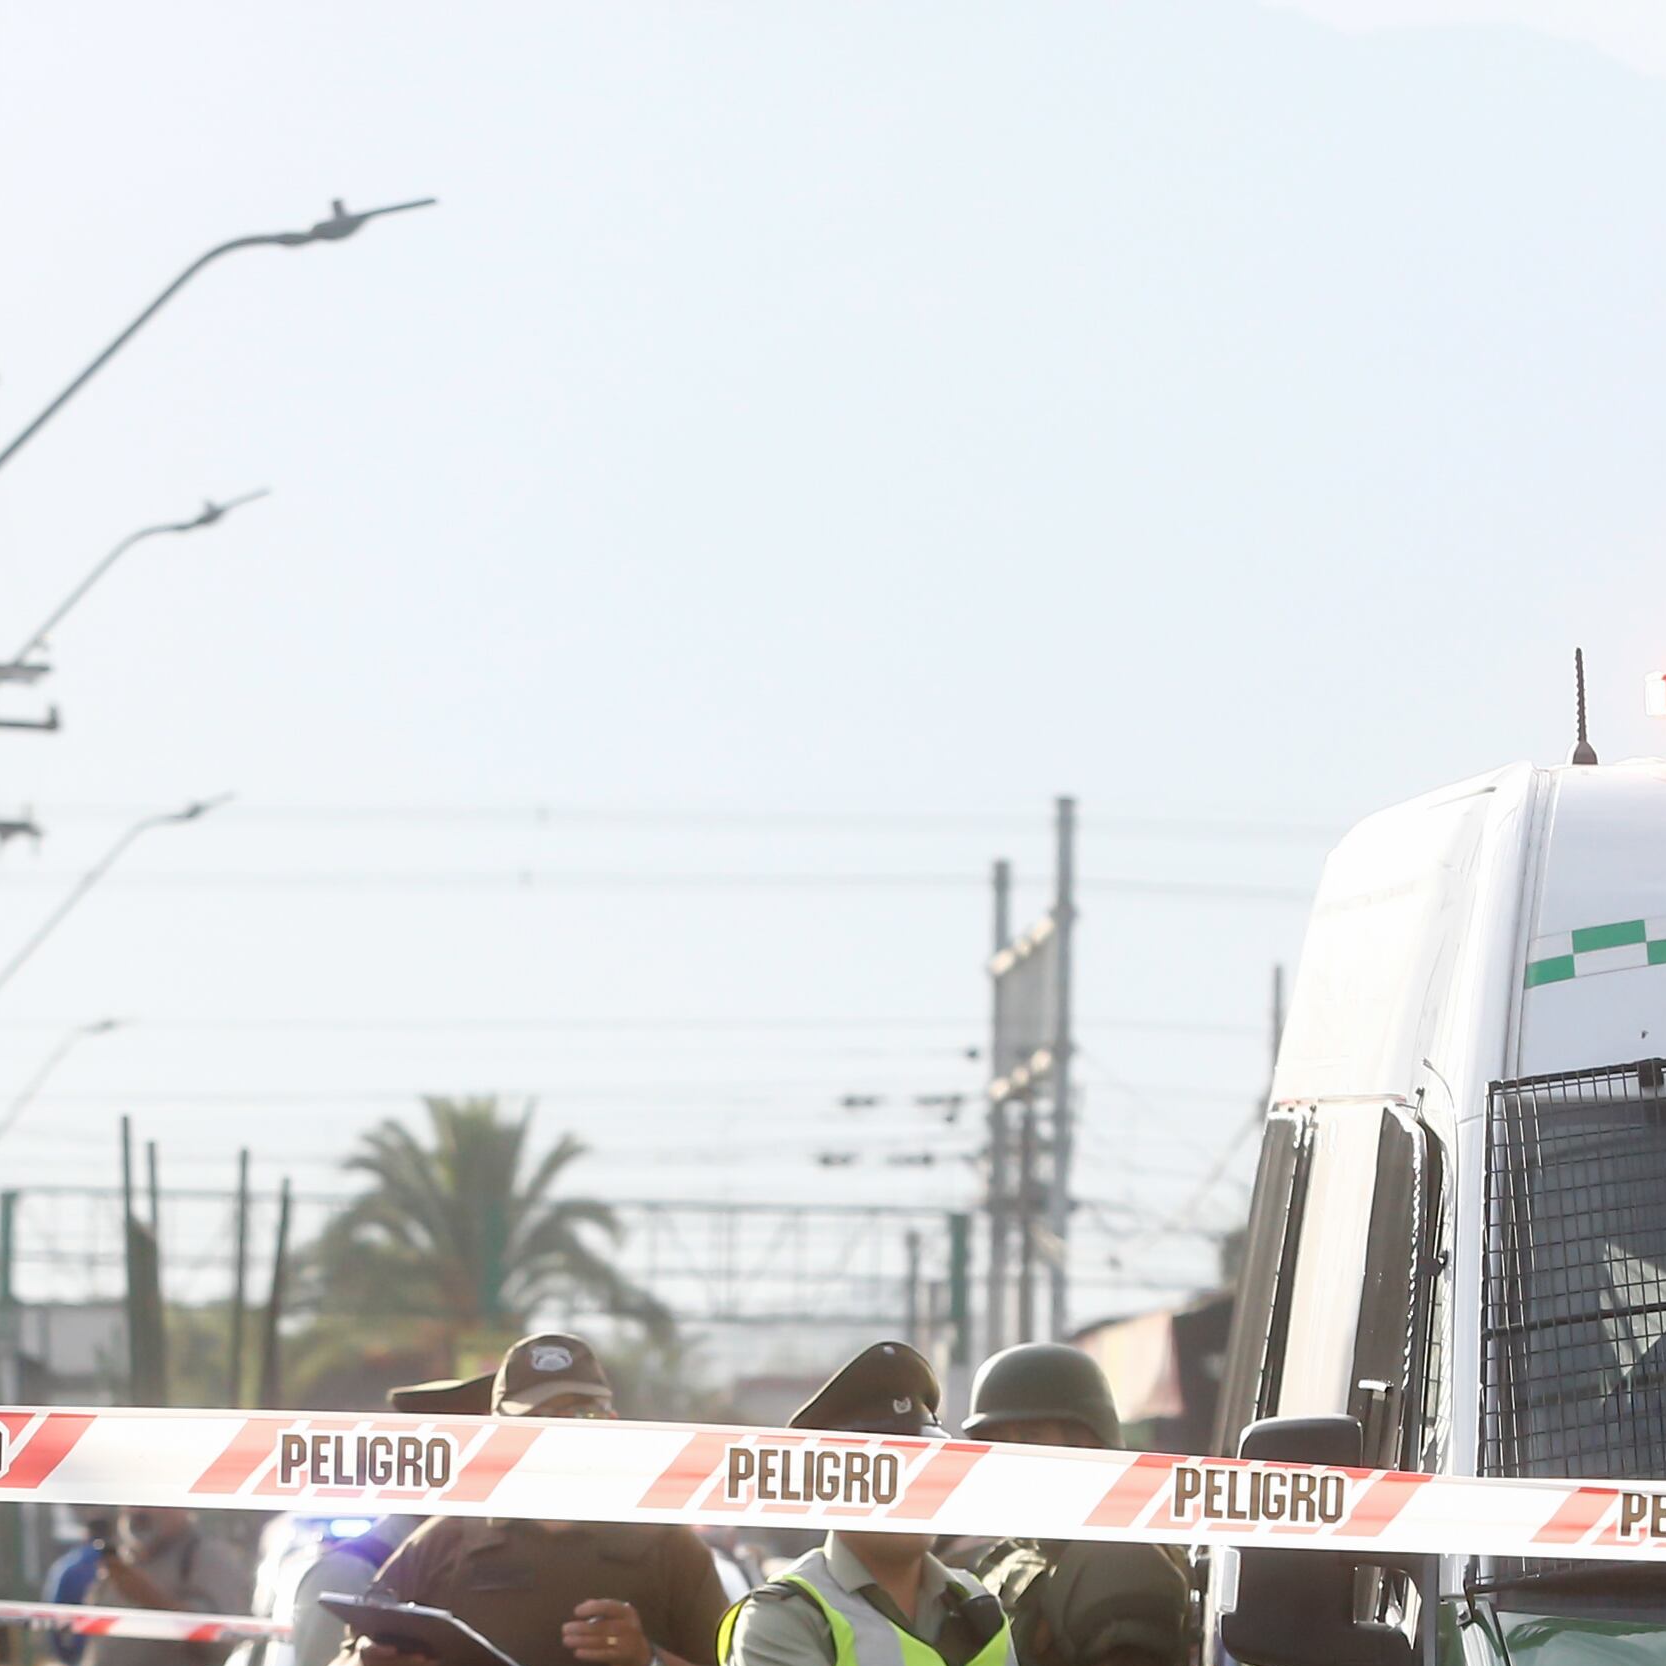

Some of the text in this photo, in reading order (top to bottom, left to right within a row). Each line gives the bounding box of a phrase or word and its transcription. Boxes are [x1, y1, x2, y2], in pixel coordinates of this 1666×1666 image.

[280, 1434, 451, 1488] PELIGRO
[727, 1447, 898, 1504] PELIGRO
[1173, 1467, 1344, 1523] PELIGRO
